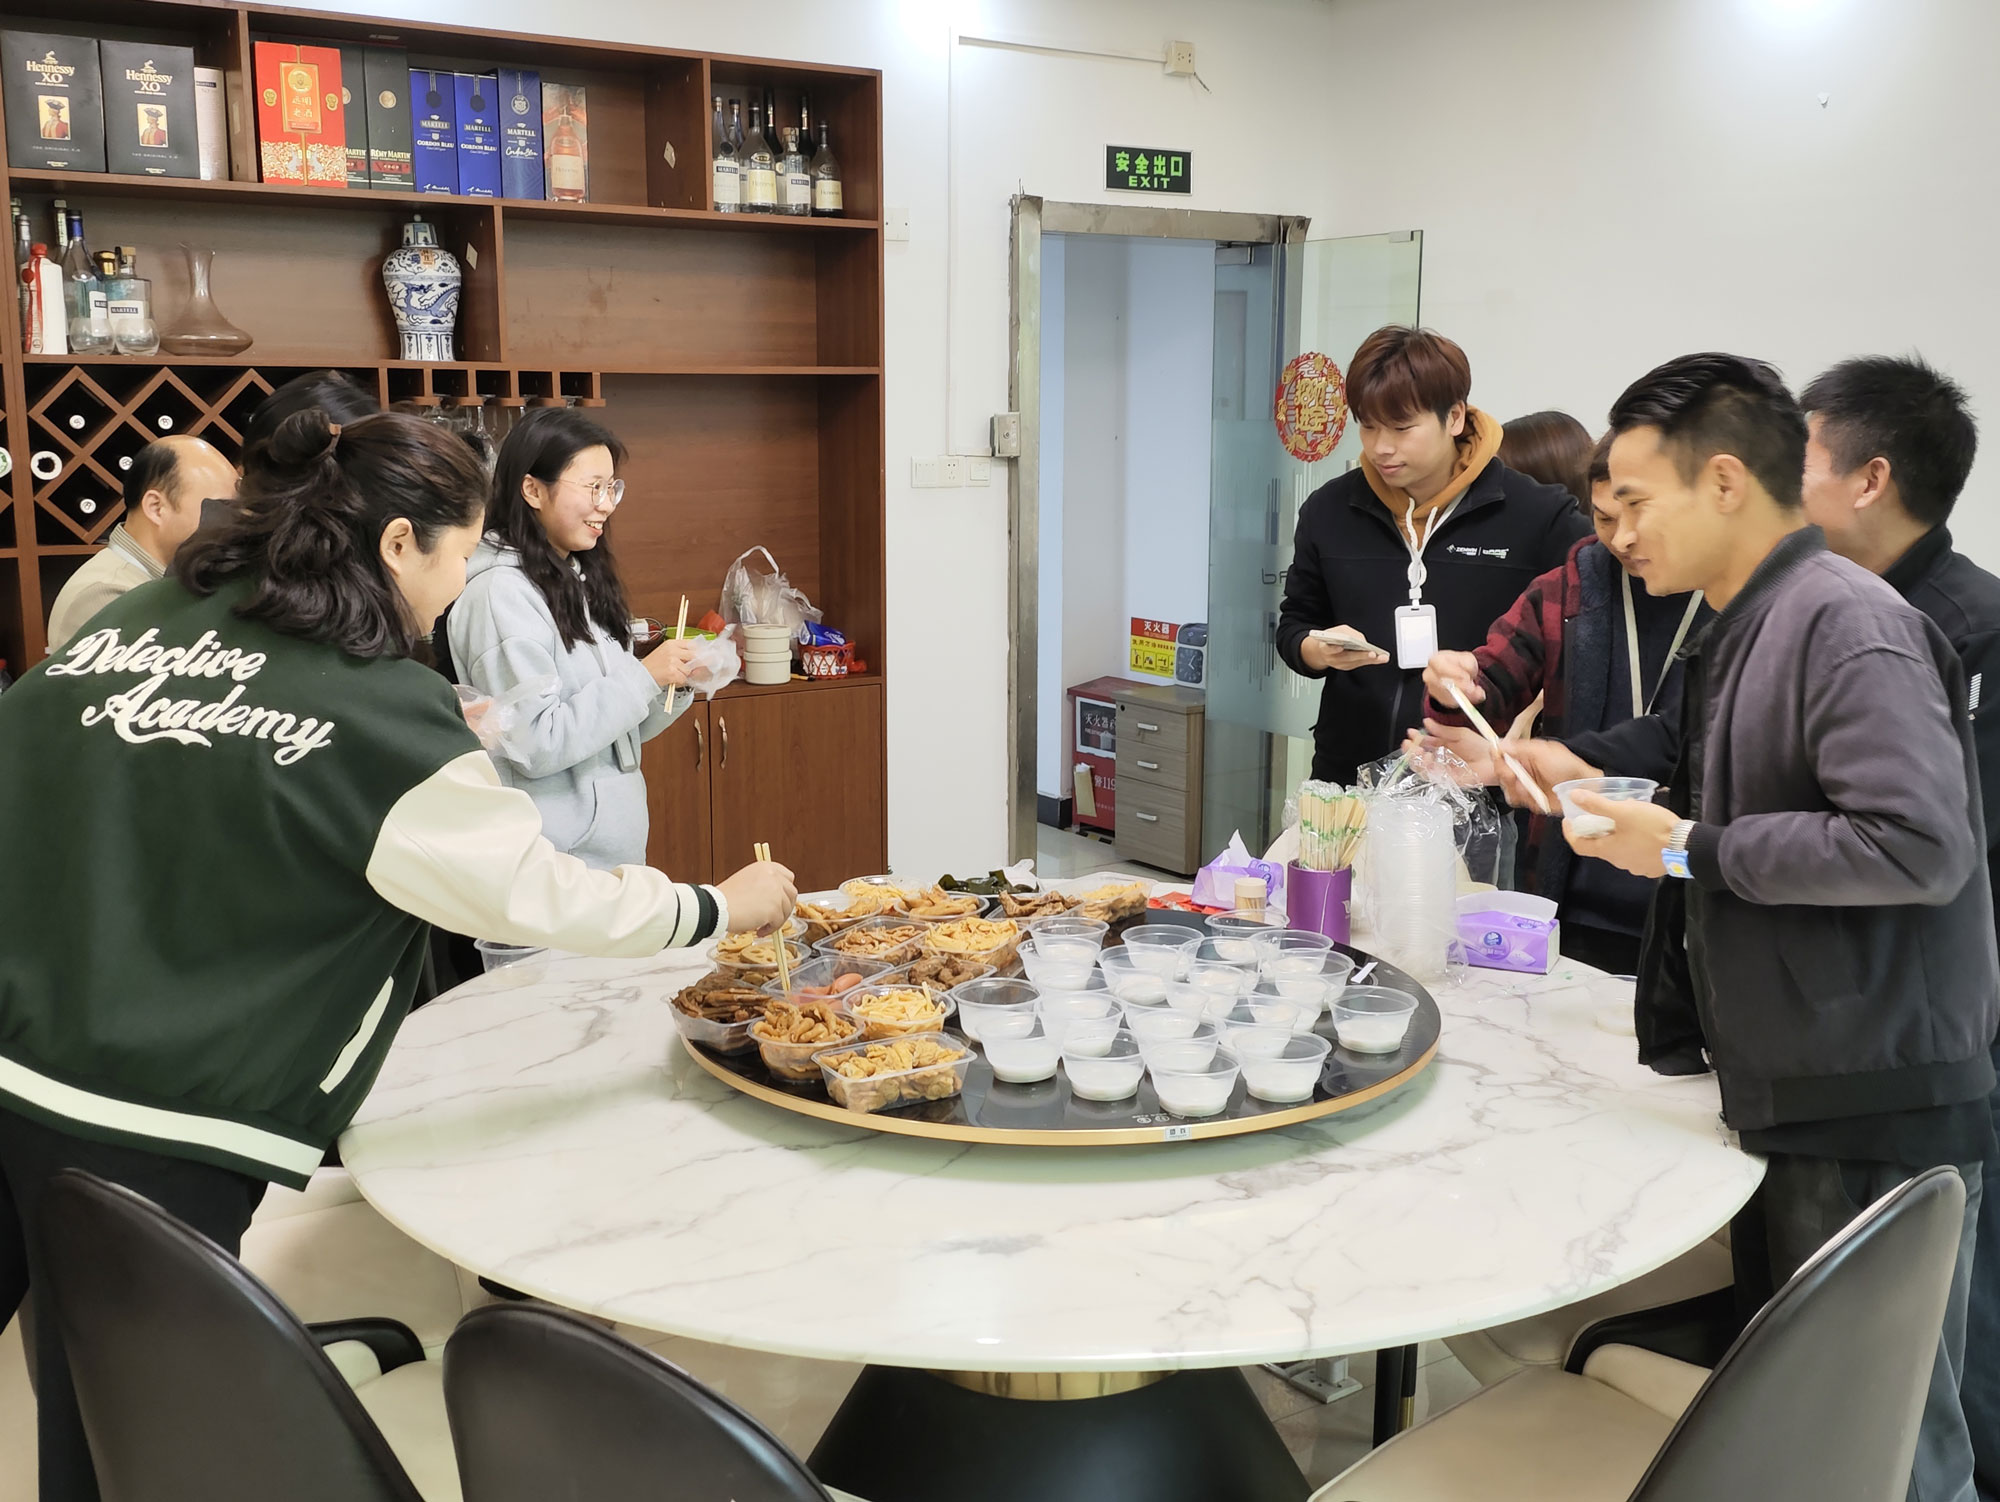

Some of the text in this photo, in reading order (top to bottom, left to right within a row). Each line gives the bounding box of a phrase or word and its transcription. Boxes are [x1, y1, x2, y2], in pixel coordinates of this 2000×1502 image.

[26, 61, 75, 76] Hennessy
[42, 73, 63, 83] XO
[124, 69, 172, 85] Hennessy
[140, 81, 161, 91] XO
[421, 121, 450, 129] MARTELL
[464, 124, 492, 132] MARTELL
[507, 128, 536, 137] MARTELL
[1116, 151, 1183, 177] 安全出口
[1128, 175, 1170, 189] EXIT
[45, 628, 267, 681] Detective
[81, 672, 336, 766] Academy
